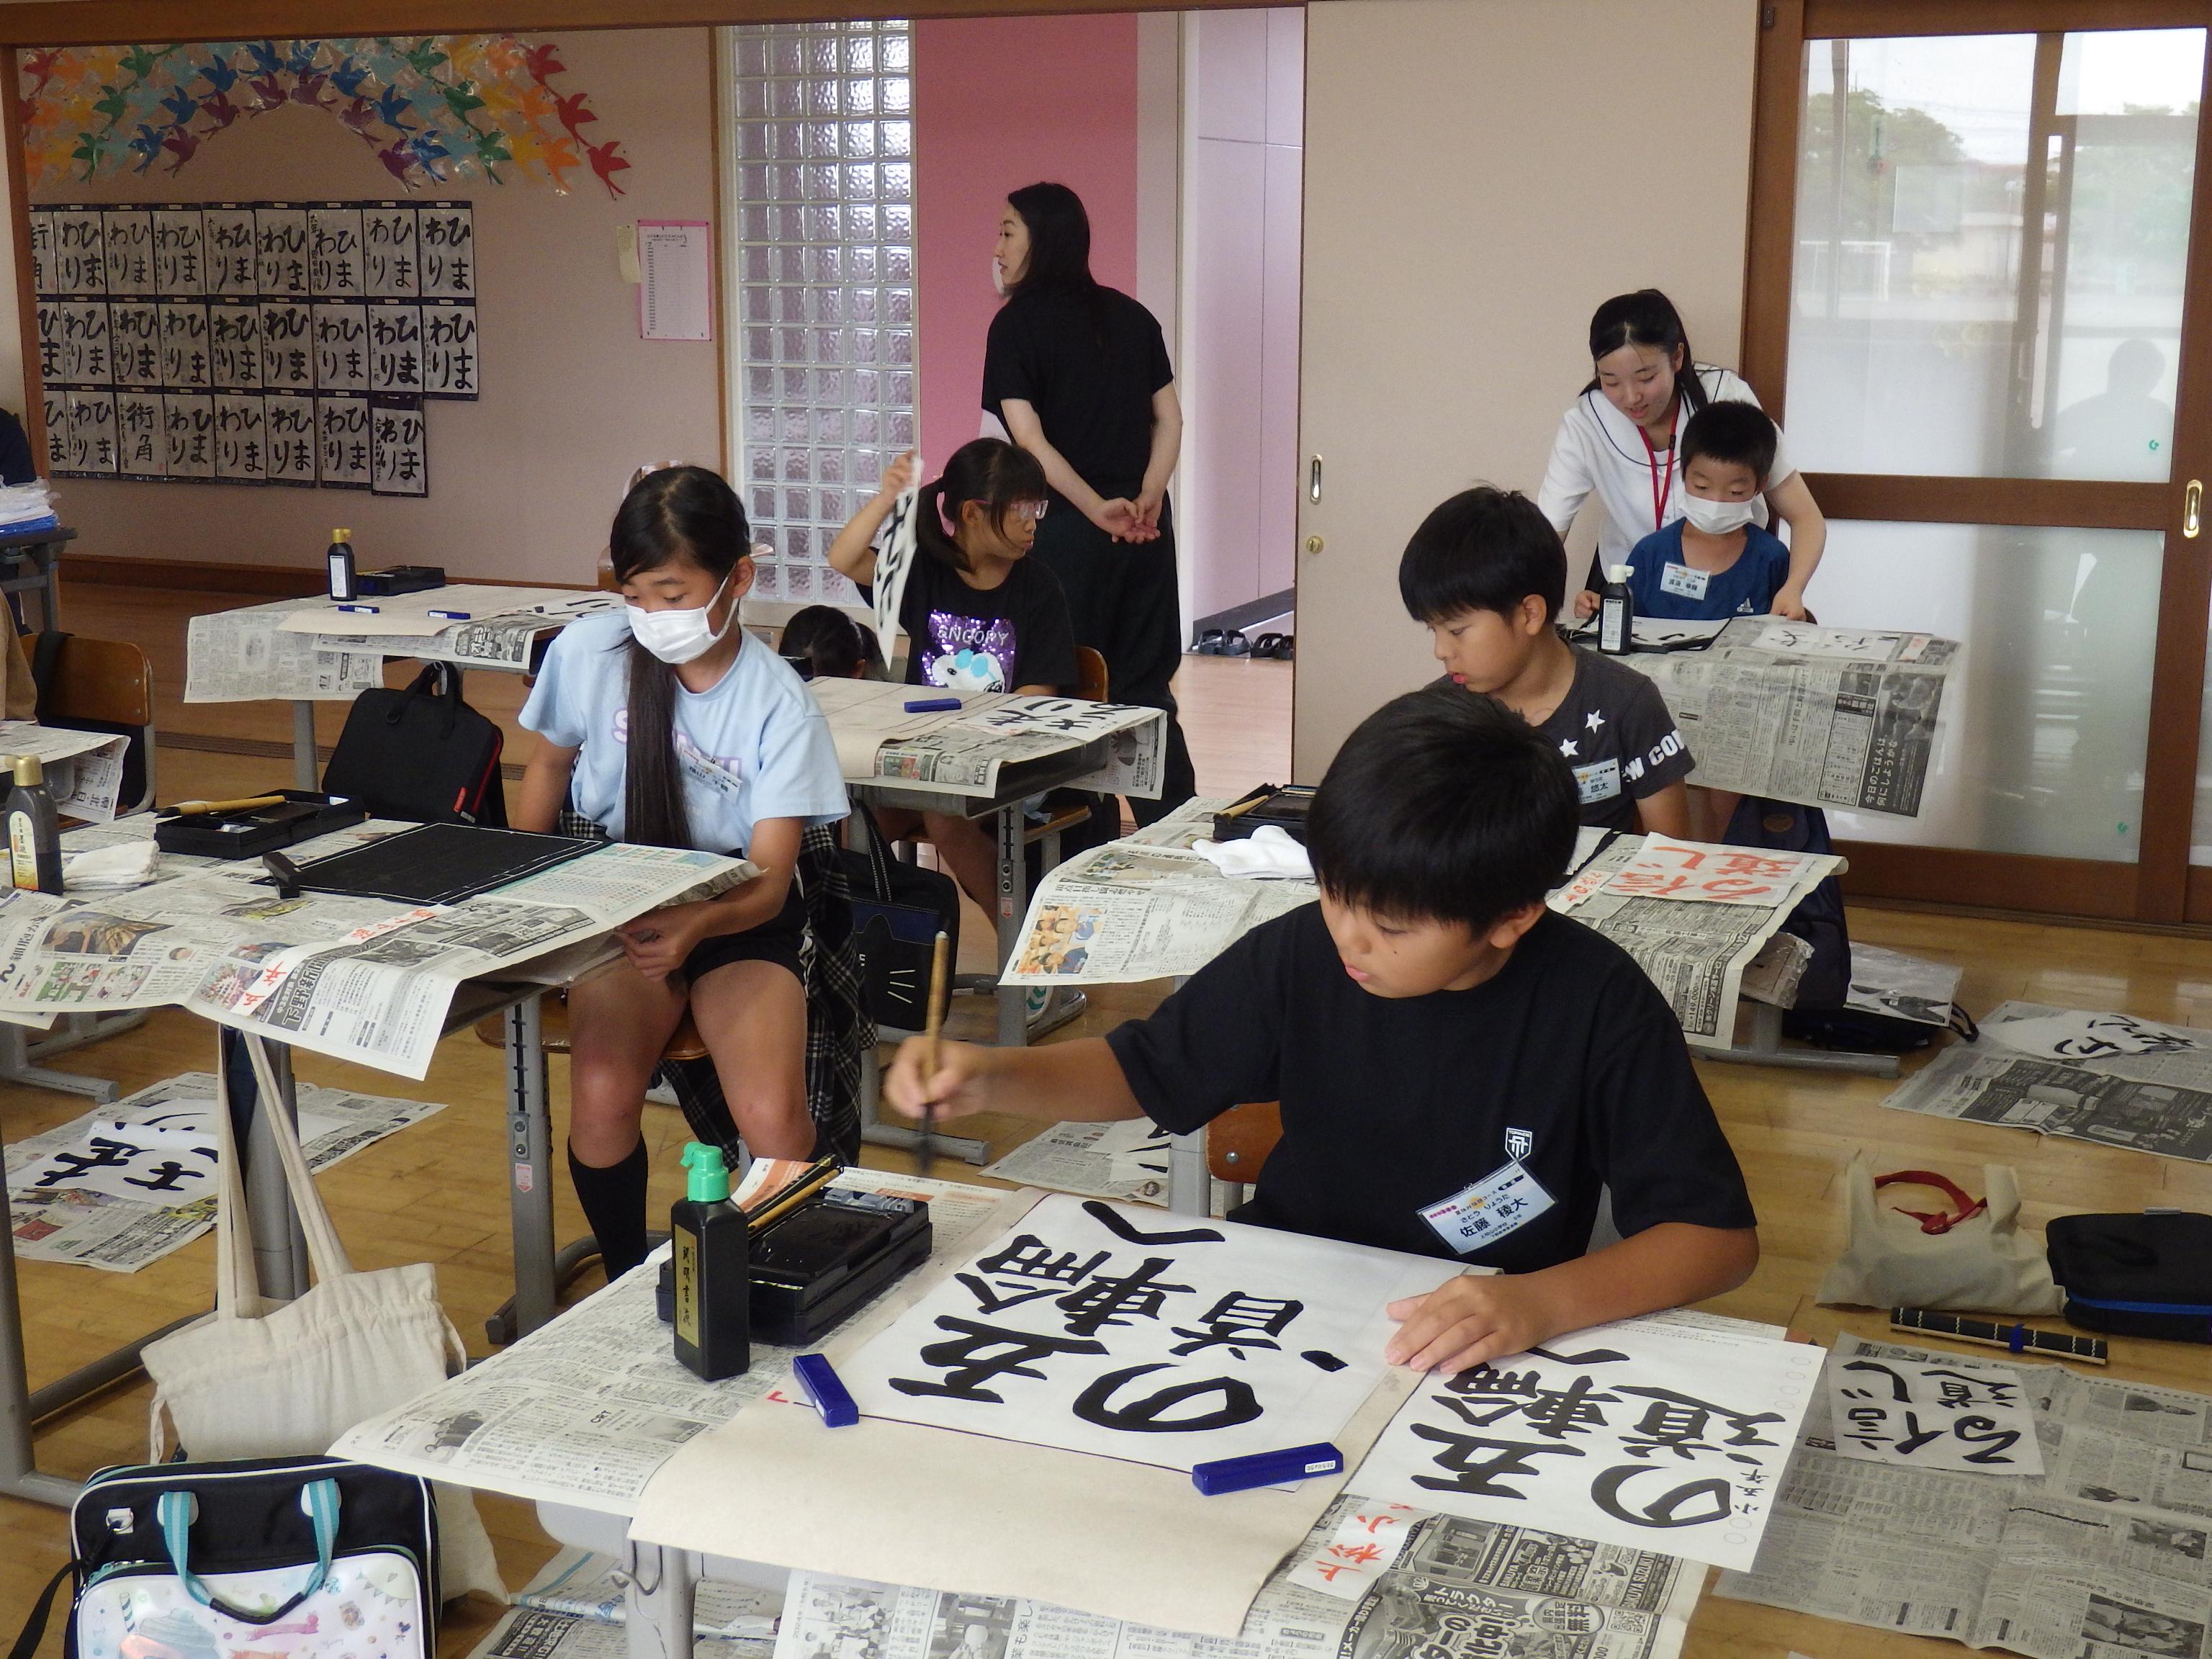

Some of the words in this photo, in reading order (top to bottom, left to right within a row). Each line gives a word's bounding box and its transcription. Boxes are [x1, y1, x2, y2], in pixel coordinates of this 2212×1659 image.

[79, 221, 104, 288] ひま
[130, 222, 149, 284] ひま
[179, 227, 200, 282] ひま
[233, 223, 251, 282] ひま
[284, 225, 306, 291] ひま
[336, 230, 357, 287] ひま
[393, 217, 412, 287] ひま
[446, 217, 470, 290] ひま
[38, 309, 60, 377] ひま
[86, 310, 105, 374] ひま
[135, 310, 156, 379] ひま
[186, 313, 206, 384] ひま
[235, 314, 258, 381] ひま
[286, 307, 309, 381] ひま
[341, 318, 364, 379] ひま
[395, 315, 419, 384] ひま
[451, 313, 475, 389] ひま
[45, 400, 66, 462] ひま
[94, 401, 113, 464] ひま
[127, 402, 154, 461] 街角
[190, 408, 211, 464] ひま
[240, 408, 263, 472] ひま
[290, 409, 313, 470] ひま
[346, 407, 368, 469] ひま
[400, 418, 423, 480] ひま
[938, 624, 1009, 646] SNOOPY
[1608, 846, 1707, 896] 信じ
[1701, 851, 1801, 900] る道
[243, 961, 287, 1007] 五年
[1460, 1216, 1491, 1238] 佐藤
[1483, 1192, 1510, 1211] りょうた
[889, 1200, 1226, 1404] 五輪へ
[1410, 1348, 1631, 1501] 五輪へ
[1841, 1360, 1950, 1455] 信じ
[1920, 1370, 2022, 1463] る道
[1591, 1384, 1786, 1529] の道
[1731, 1466, 1771, 1515] 小五年
